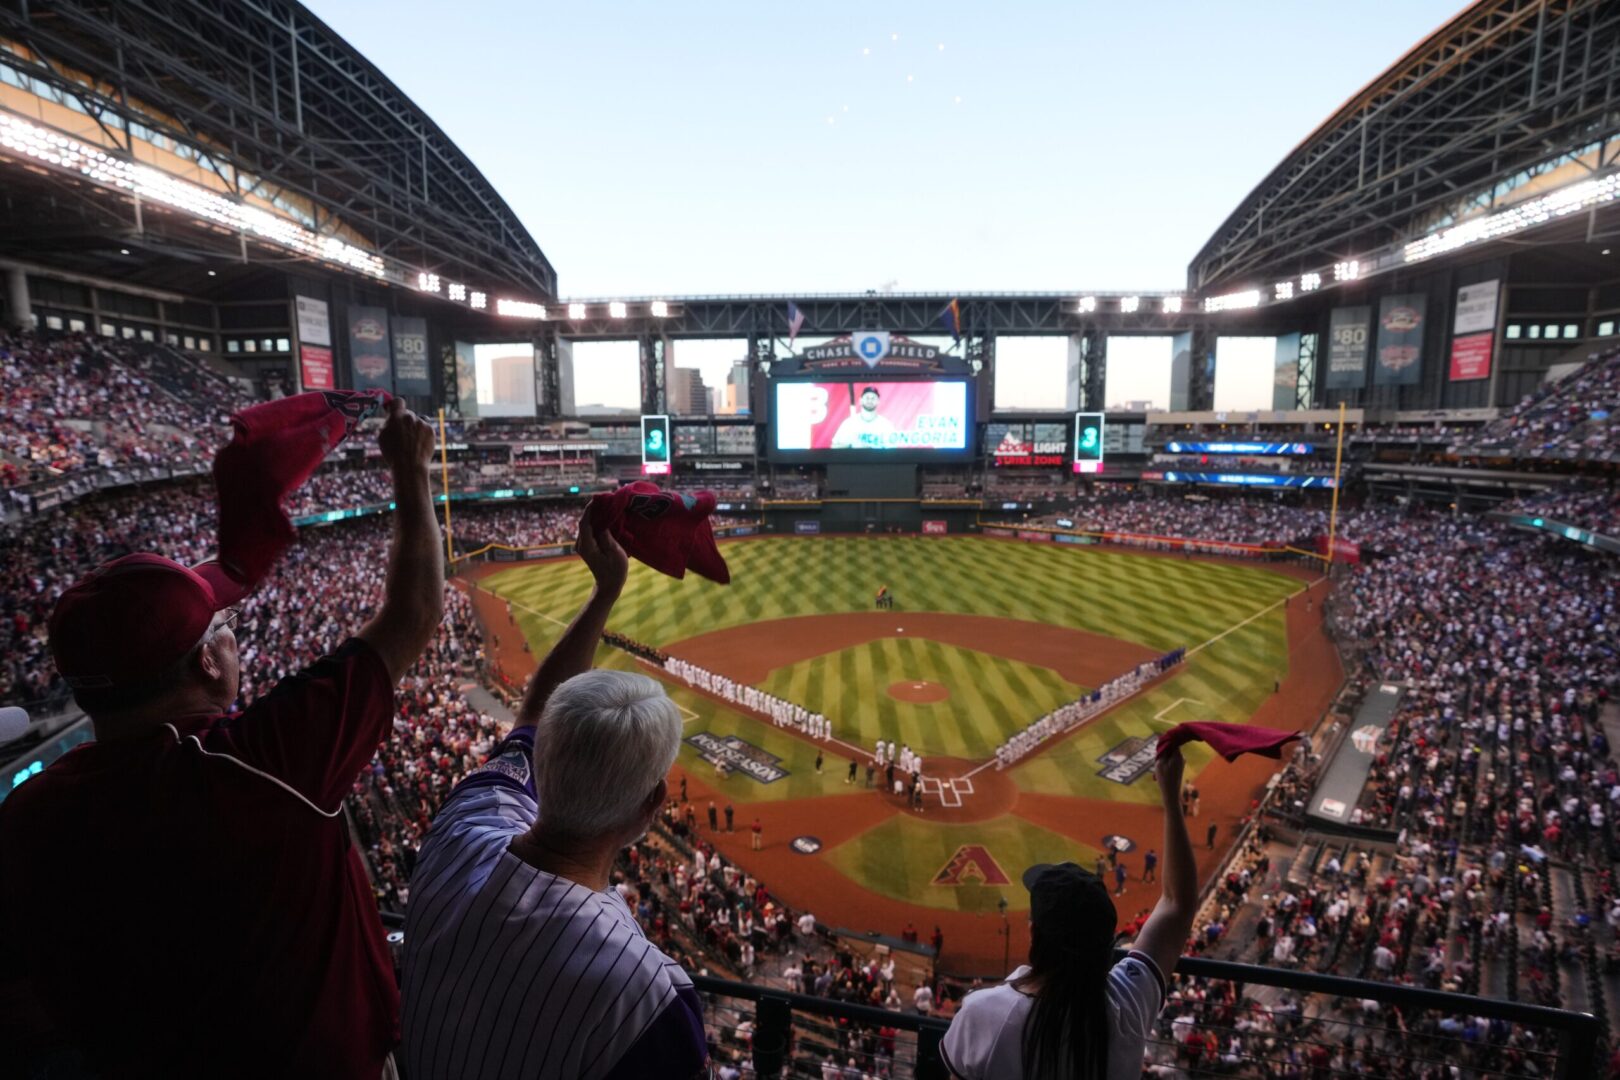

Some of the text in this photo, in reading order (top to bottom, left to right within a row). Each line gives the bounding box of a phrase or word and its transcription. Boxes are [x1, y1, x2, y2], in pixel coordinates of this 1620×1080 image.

[1334, 329, 1366, 344] $80
[395, 338, 425, 354] $80
[807, 345, 936, 360] CHASE FIELD
[917, 415, 959, 429] EVAN
[648, 429, 663, 450] 3
[881, 431, 957, 444] LONGORIA
[1083, 427, 1097, 447] 3
[1033, 442, 1067, 454] LIGHT
[995, 455, 1063, 466] STRIKE ZONE
[690, 734, 782, 782] POSTSEASON
